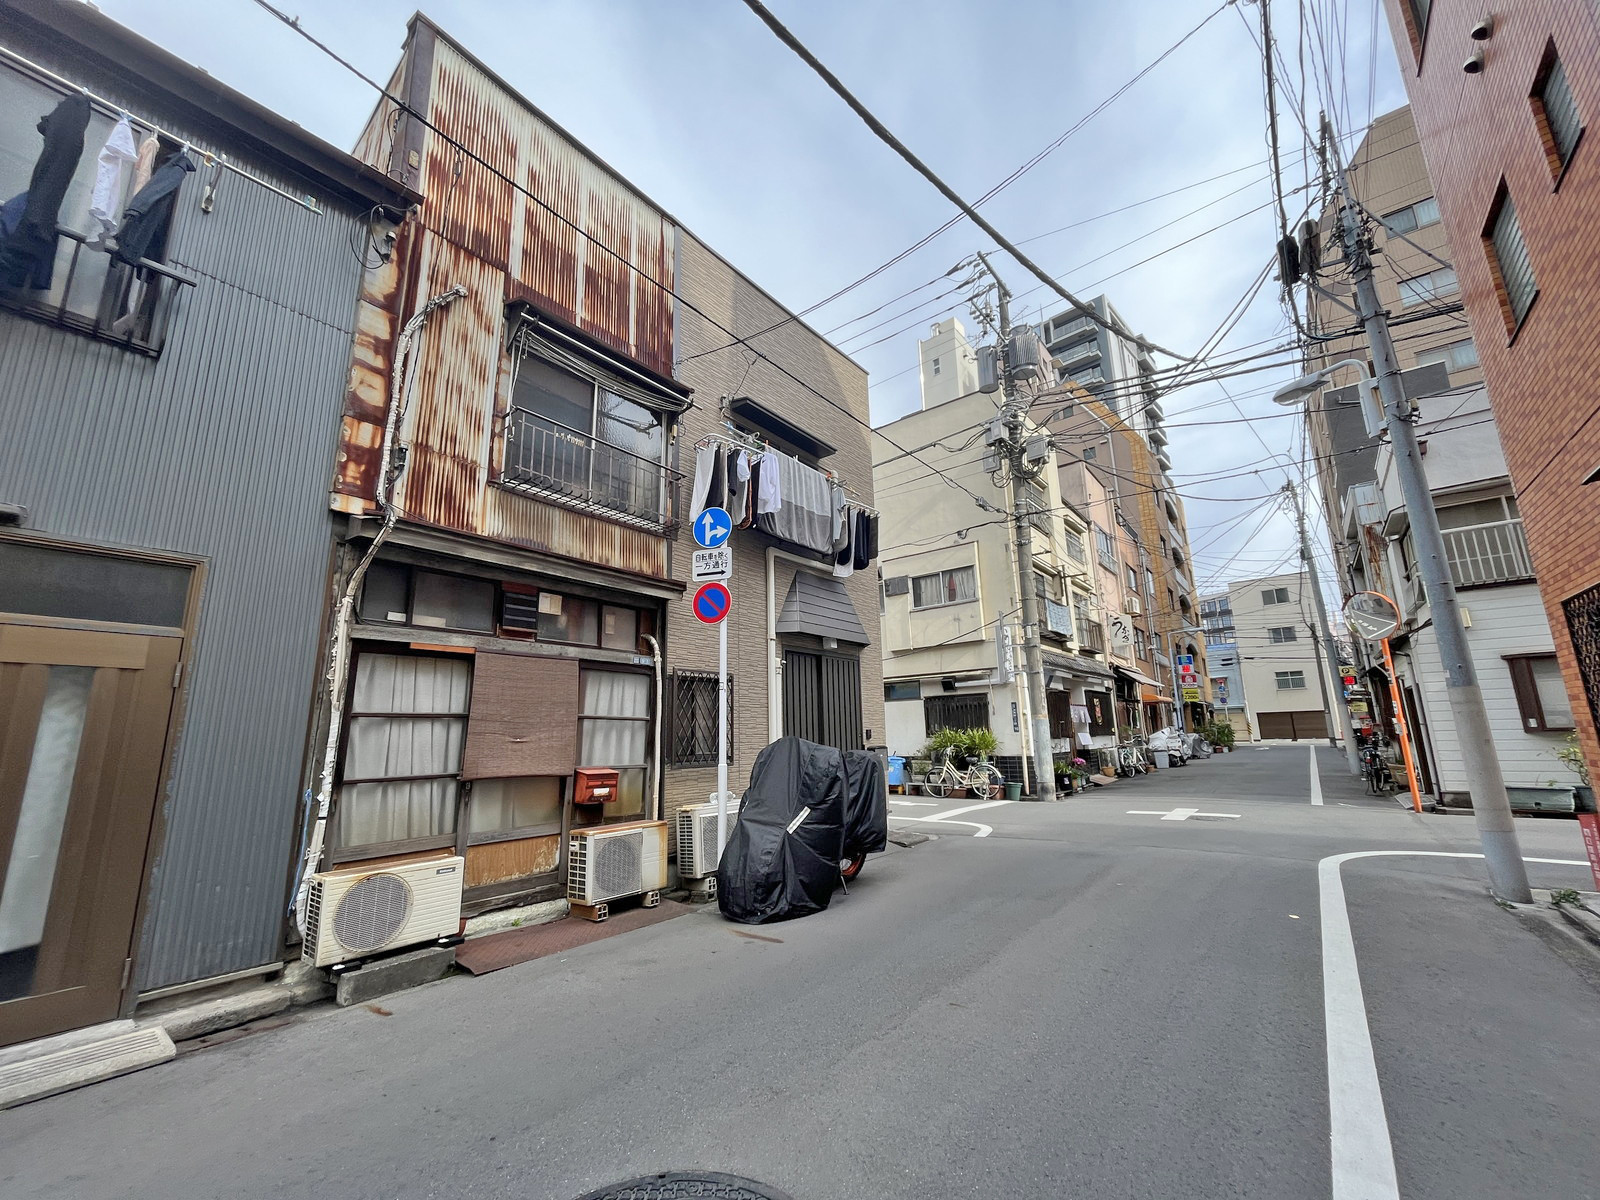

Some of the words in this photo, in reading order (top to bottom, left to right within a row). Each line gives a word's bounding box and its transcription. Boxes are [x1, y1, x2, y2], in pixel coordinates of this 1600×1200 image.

[695, 551, 729, 562] 自転車を除く
[695, 560, 728, 570] 一方通行
[1111, 617, 1130, 643] うなぎ
